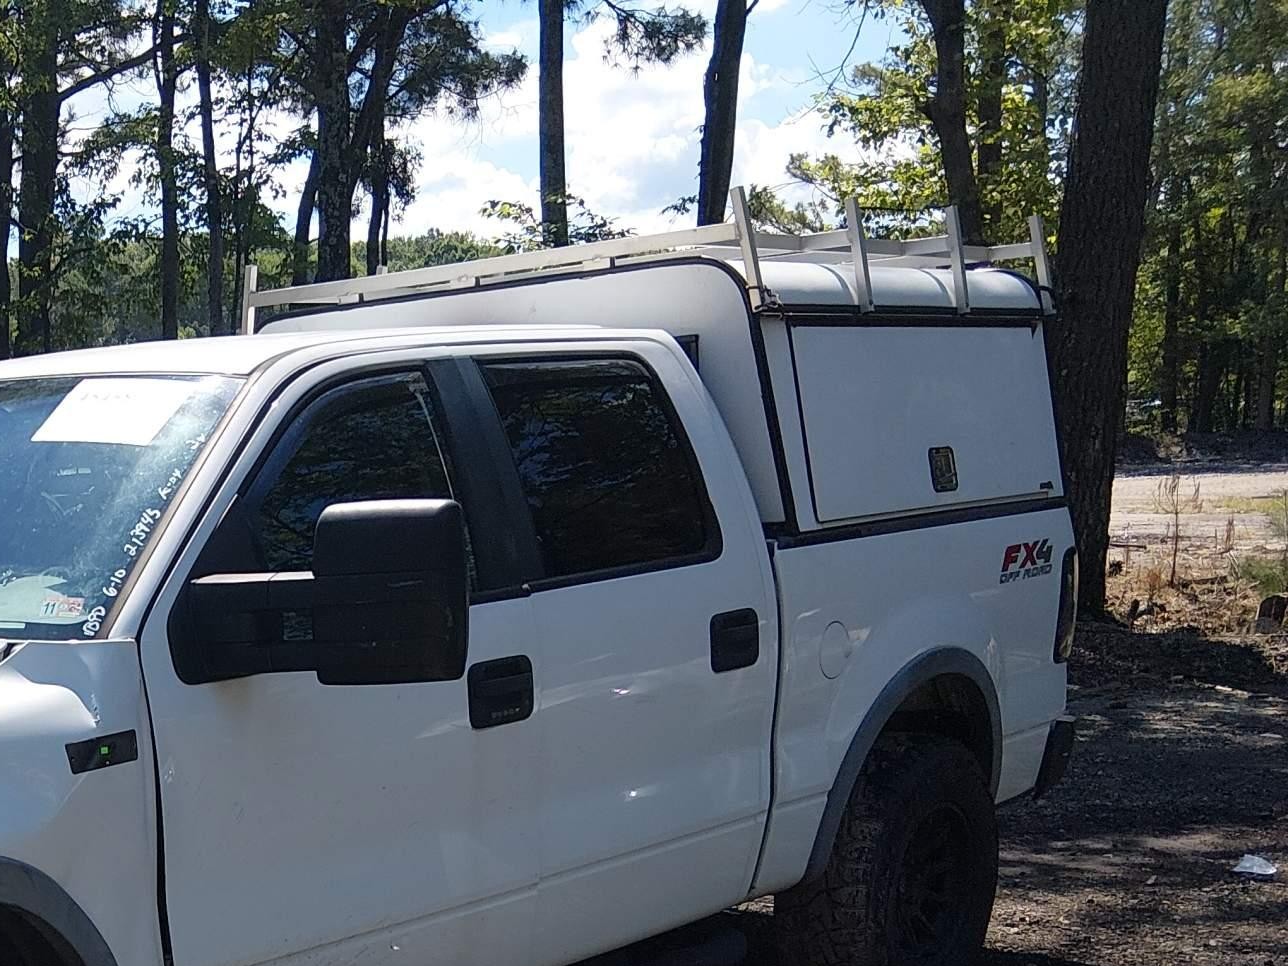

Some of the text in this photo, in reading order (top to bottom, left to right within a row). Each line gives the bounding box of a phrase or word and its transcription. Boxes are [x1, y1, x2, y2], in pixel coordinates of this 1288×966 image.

[124, 507, 161, 556] 213945
[1001, 538, 1053, 572] FX4
[999, 563, 1053, 585] OFF ROAD
